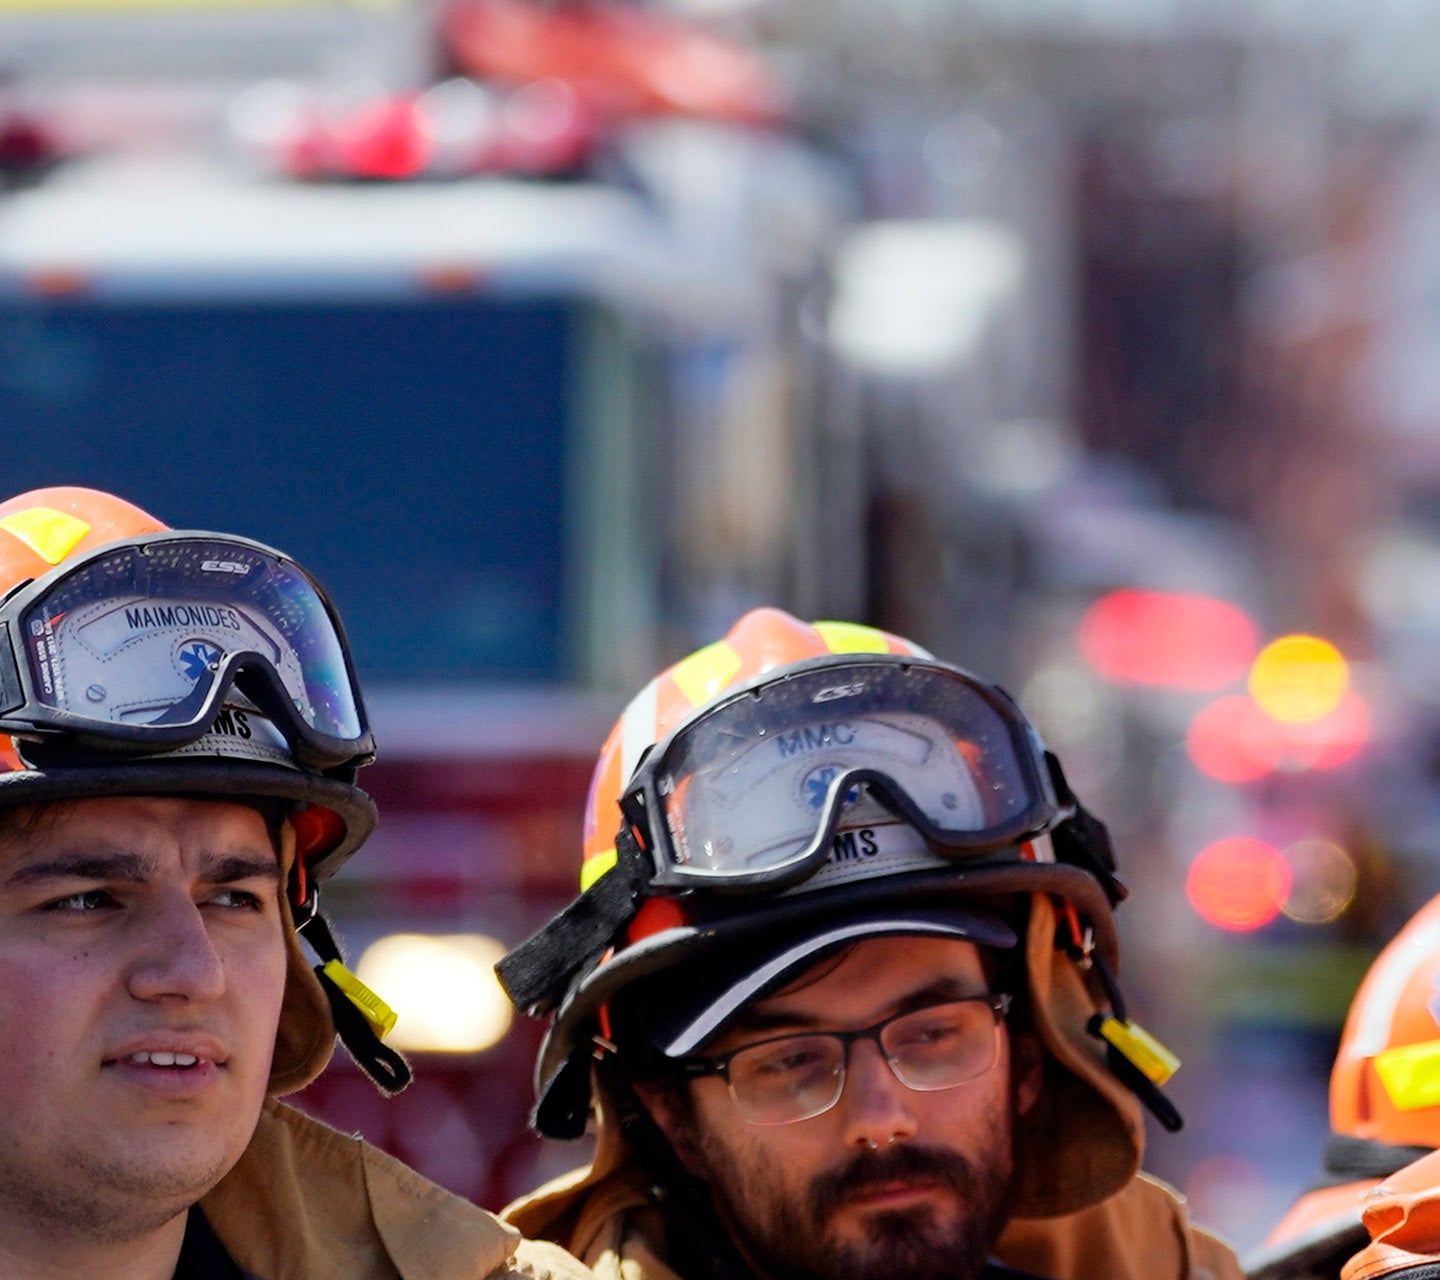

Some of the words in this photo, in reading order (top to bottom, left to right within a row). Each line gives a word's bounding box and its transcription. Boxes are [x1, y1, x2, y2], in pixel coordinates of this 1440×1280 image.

[124, 605, 241, 631] MAIMONIDES
[207, 709, 252, 739] MS
[776, 722, 856, 759] MMC
[827, 829, 878, 863] MS
